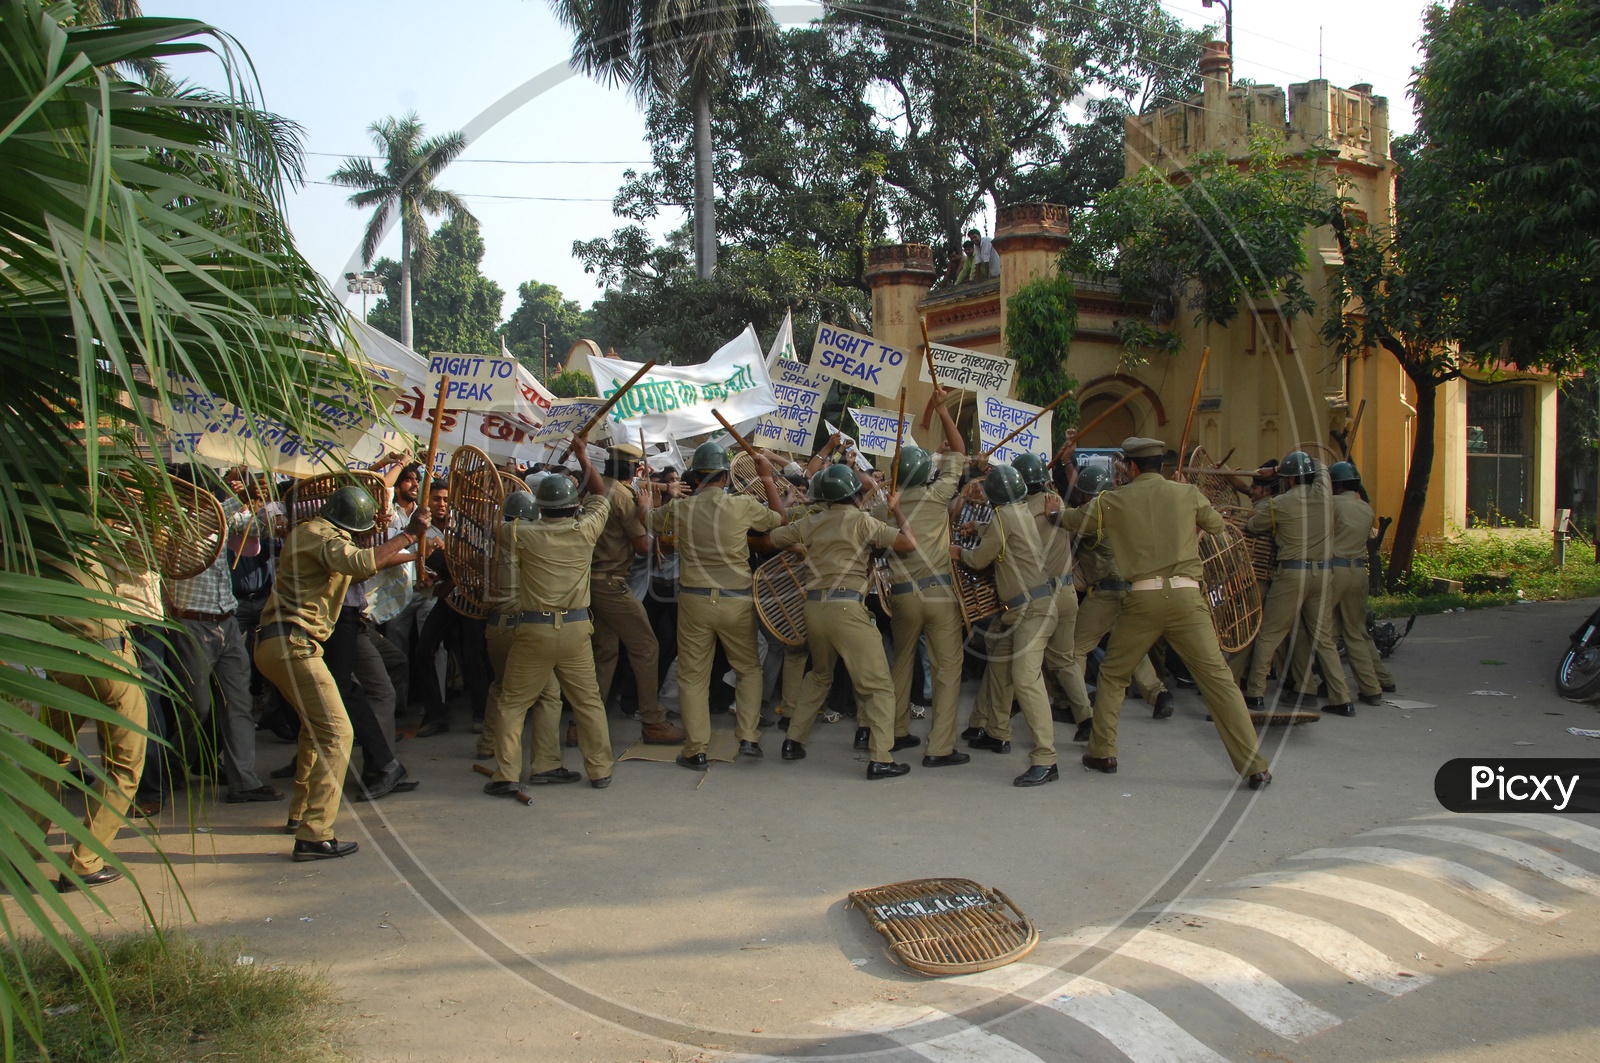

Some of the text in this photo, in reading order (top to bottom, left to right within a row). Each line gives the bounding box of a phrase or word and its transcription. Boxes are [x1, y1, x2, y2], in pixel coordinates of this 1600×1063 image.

[818, 328, 874, 357] RIGHT
[879, 345, 903, 366] TO
[429, 356, 513, 378] RIGHT TO
[777, 359, 809, 375] RIGHT
[819, 350, 882, 385] SPEAK
[433, 380, 493, 402] SPEAK
[781, 371, 820, 389] SPEAK
[874, 894, 988, 920] POLICE
